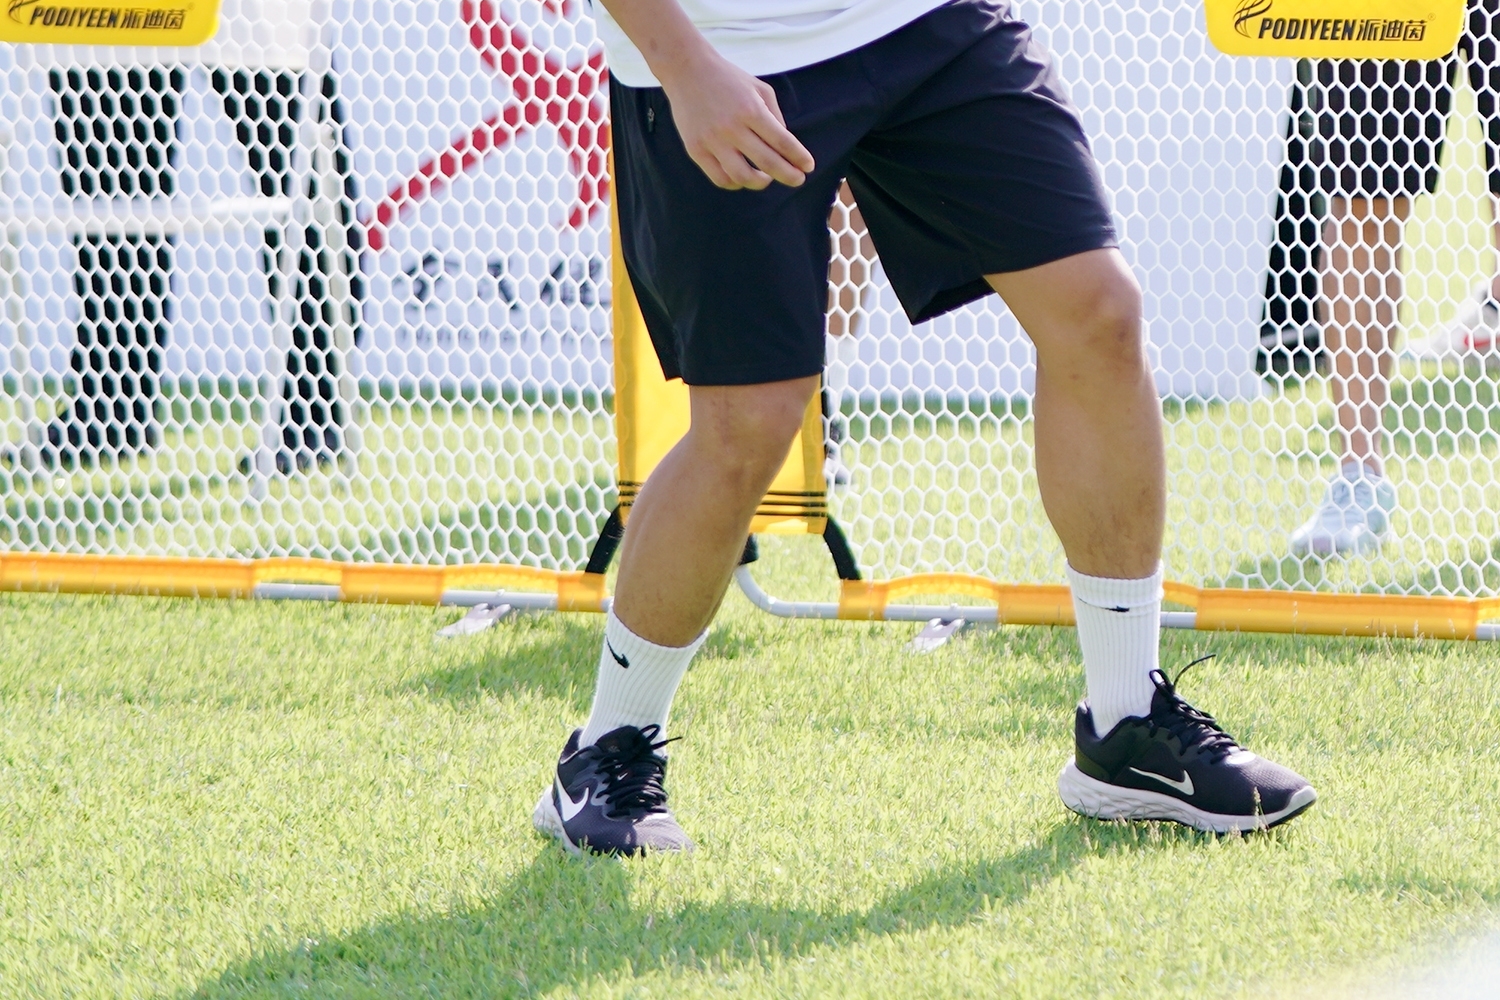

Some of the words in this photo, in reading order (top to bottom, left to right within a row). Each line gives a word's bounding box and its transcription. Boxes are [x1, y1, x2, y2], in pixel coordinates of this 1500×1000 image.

[29, 5, 121, 29] PODIYEEN
[120, 7, 188, 30] 派迪茵
[1258, 17, 1356, 41] PODIYEEN
[1355, 18, 1428, 42] 派迪茵
